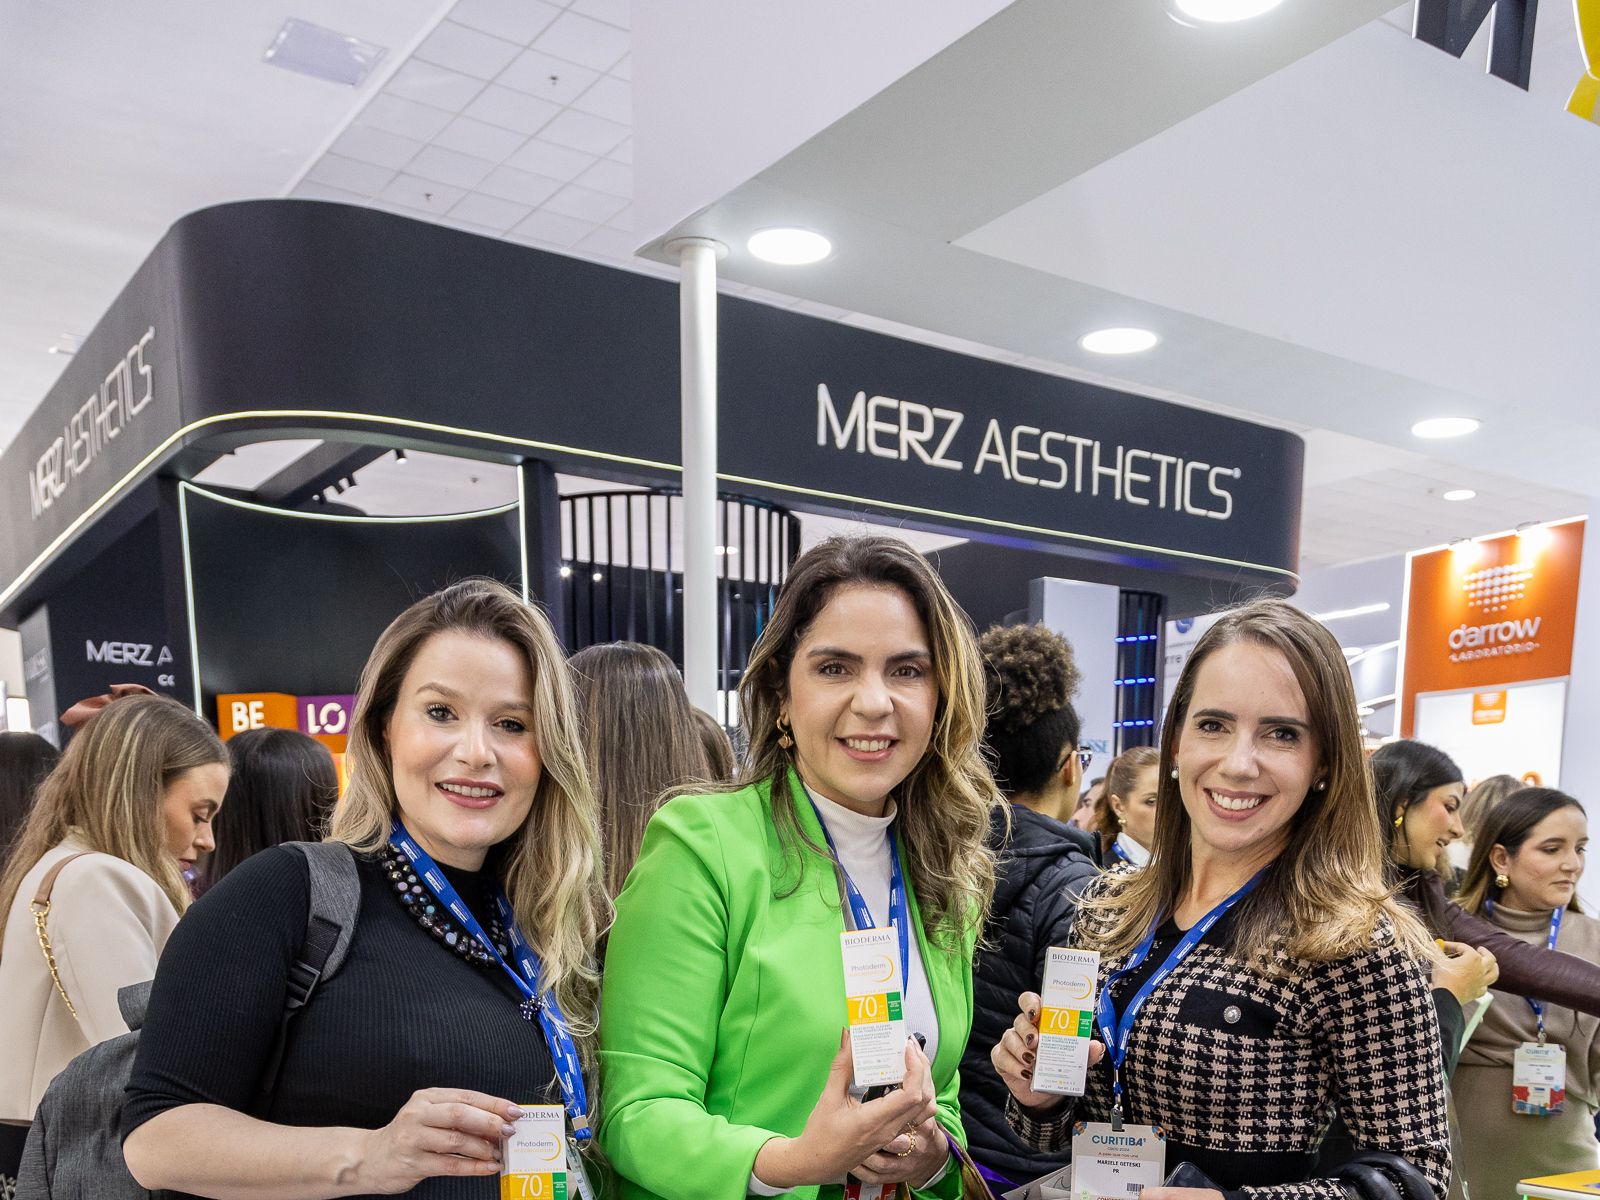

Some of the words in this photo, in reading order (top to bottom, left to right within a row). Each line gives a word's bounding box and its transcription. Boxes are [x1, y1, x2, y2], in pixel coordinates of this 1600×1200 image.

[817, 383, 964, 470] MERZ
[974, 419, 1234, 519] AESTHETICS
[1449, 616, 1542, 650] darrow
[86, 639, 154, 667] MERZ
[231, 700, 265, 732] BE
[845, 934, 891, 946] BIODERMA
[1052, 953, 1095, 964] BIODERMA
[854, 996, 878, 1019] 70
[1047, 1009, 1070, 1030] 70
[516, 1174, 543, 1198] 70
